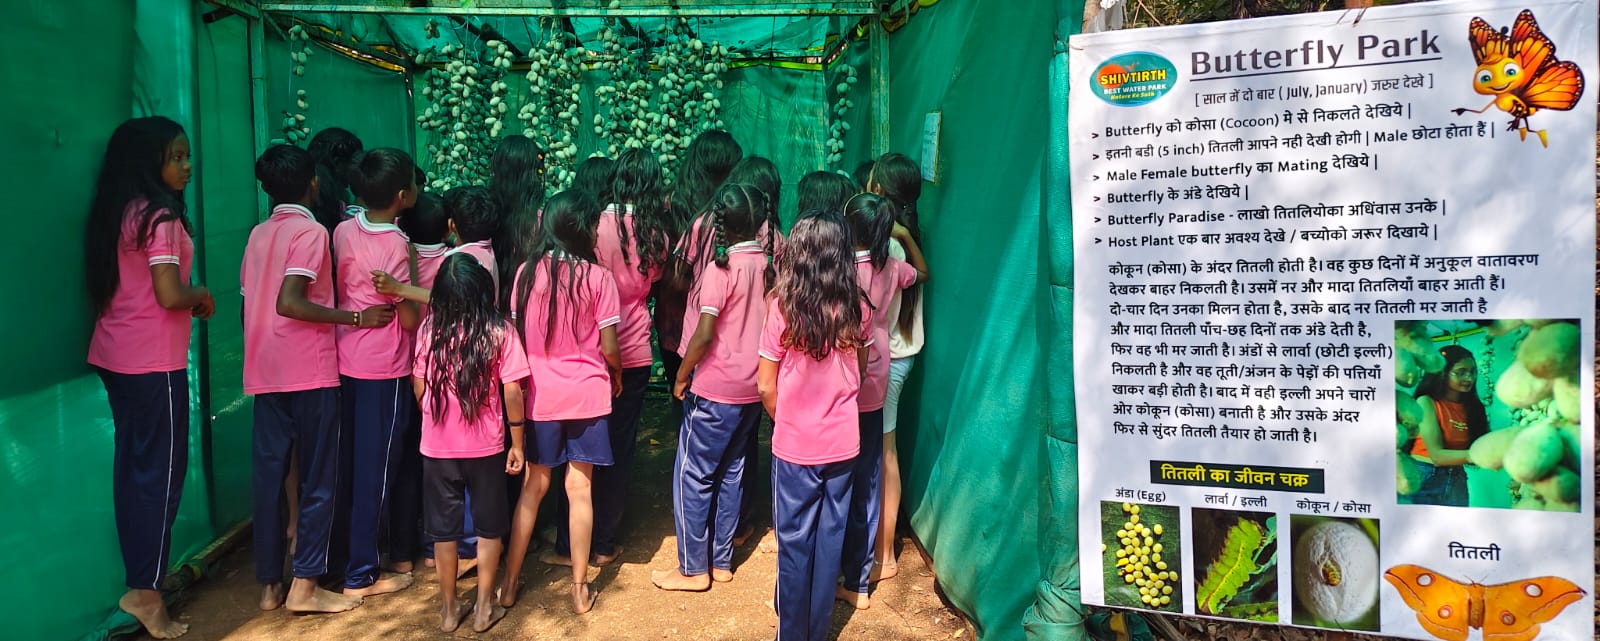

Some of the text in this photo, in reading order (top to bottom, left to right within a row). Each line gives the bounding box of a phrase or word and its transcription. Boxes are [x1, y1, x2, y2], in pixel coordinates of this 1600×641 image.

[1191, 29, 1441, 76] Butterfly Park
[1100, 69, 1167, 85] SHIVTIRTH
[1103, 83, 1167, 95] BEST WATER PARK
[1202, 93, 1227, 105] साल
[1229, 87, 1240, 102] में
[1242, 87, 1254, 102] दो
[1256, 88, 1276, 100] बार
[1402, 73, 1425, 88] देखे
[1105, 122, 1163, 138] Butterfly
[1165, 118, 1182, 133] को
[1185, 117, 1217, 131] कोसा
[1220, 113, 1279, 131] (Cocoon)
[1296, 108, 1309, 124] से
[1312, 105, 1361, 123] निकलते
[1365, 101, 1404, 119] देखिये
[1105, 145, 1132, 161] इतनी
[1173, 143, 1205, 156] inch)
[1208, 137, 1244, 153] तितली
[1247, 135, 1278, 151] आपने
[1281, 133, 1303, 149] नही
[1306, 131, 1332, 148] देखी
[1335, 129, 1362, 146] होगी
[1374, 129, 1408, 143] Male
[1411, 125, 1442, 140] छोटा
[1444, 123, 1473, 139] होता
[1107, 152, 1370, 181] Male Female butterfly का Mating देखिये
[1107, 183, 1241, 205] Butterfly के अंडे देखिये
[1108, 212, 1165, 227] Butterfly
[1168, 210, 1225, 224] Paradise
[1236, 205, 1270, 221] लाखो
[1404, 197, 1438, 214] उनके
[1108, 236, 1138, 247] Host
[1141, 234, 1175, 247] Plant
[1177, 234, 1198, 245] एक
[1200, 233, 1221, 245] बार
[1224, 232, 1261, 244] अवश्य
[1263, 227, 1286, 244] देखे
[1386, 222, 1430, 239] दिखाये
[1108, 254, 1540, 279] कोकून (कोसा) के अंदर तितली होती है। वह कुछ दिनों में अनुकूल वातावरण
[1109, 273, 1505, 296] देखकर बाहर निकलती है। उसमें नर और मादा तितलियाँ बाहर आती हैं।
[1109, 296, 1488, 317] दो-चार दिन उनका मिलन होता है, उसके बाद नर तितली मर जाती है
[1110, 321, 1131, 336] और
[1133, 325, 1158, 336] मादा
[1160, 321, 1197, 336] तितली
[1250, 321, 1277, 337] दिनों
[1279, 325, 1303, 336] तक
[1305, 321, 1327, 336] अंडे
[1329, 321, 1355, 337] देती
[1357, 320, 1372, 338] है,
[1110, 341, 1393, 360] फिर वह भी मर जाती है। अंडों से लार्वा (छोटी इल्ली)
[1111, 361, 1157, 376] निकलती
[1159, 361, 1169, 377] है
[1171, 361, 1193, 376] और
[1195, 365, 1213, 378] वह
[1279, 363, 1293, 378] के
[1295, 363, 1320, 381] पेड़ों
[1322, 364, 1340, 379] की
[1343, 364, 1382, 380] पत्तियाँ
[1112, 382, 1376, 401] खाकर बड़ी होती है। बाद में वही इल्ली अपने चारों
[1161, 463, 1309, 487] तितली का जीवन चक्र
[1115, 487, 1166, 503] अंडा (Egg)
[1204, 492, 1268, 508] लार्वा इल्ली
[1296, 497, 1372, 514] कोकून कोसा
[1448, 541, 1501, 561] तितली
